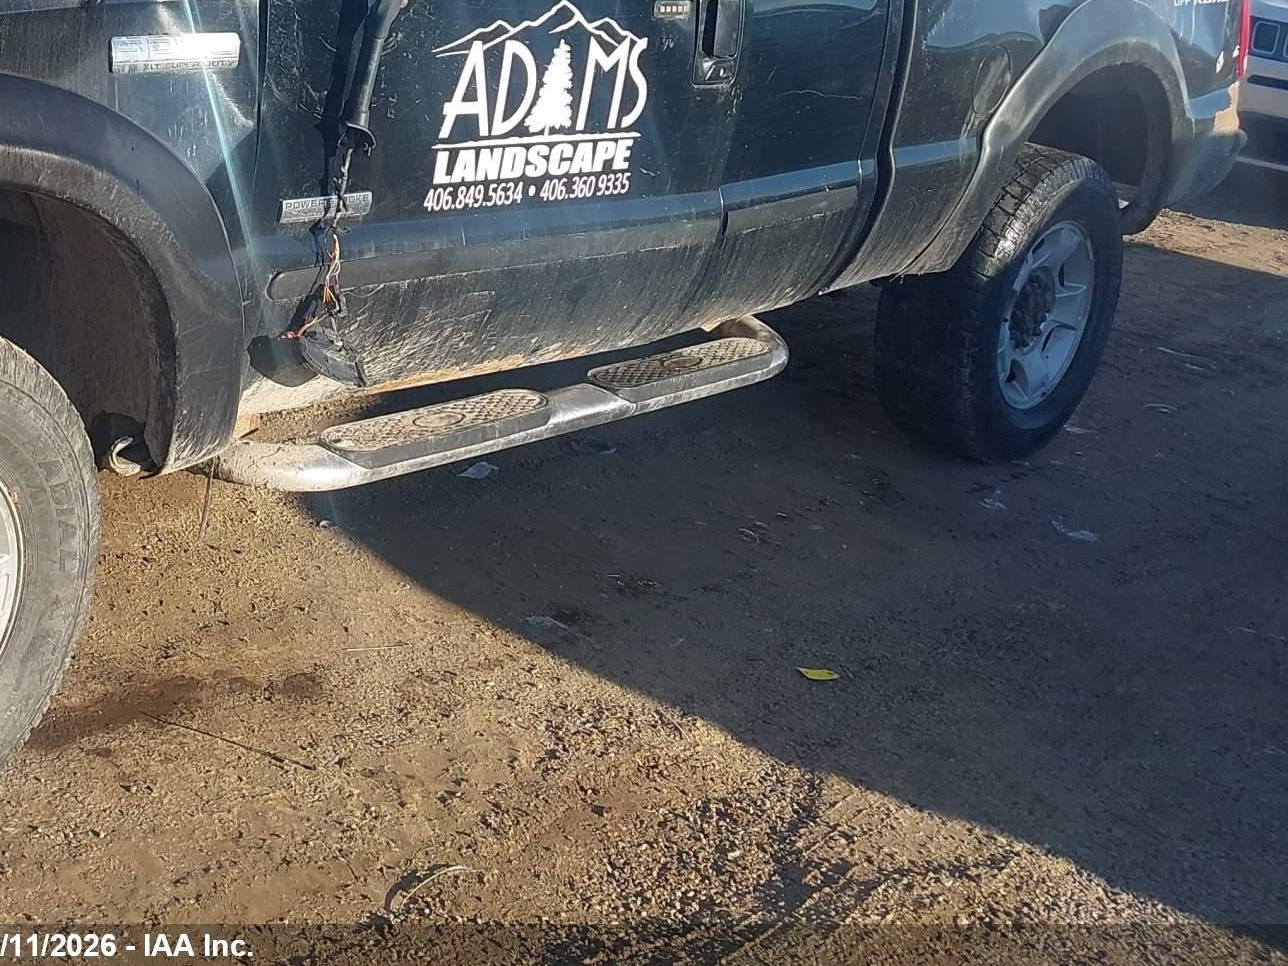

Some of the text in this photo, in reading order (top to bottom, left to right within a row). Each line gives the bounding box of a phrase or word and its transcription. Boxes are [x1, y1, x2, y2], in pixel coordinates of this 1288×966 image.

[143, 62, 160, 71] XLT
[433, 138, 634, 185] LANDSCAPE
[285, 195, 368, 210] POWERSOKE
[423, 181, 523, 212] 406.849.5634
